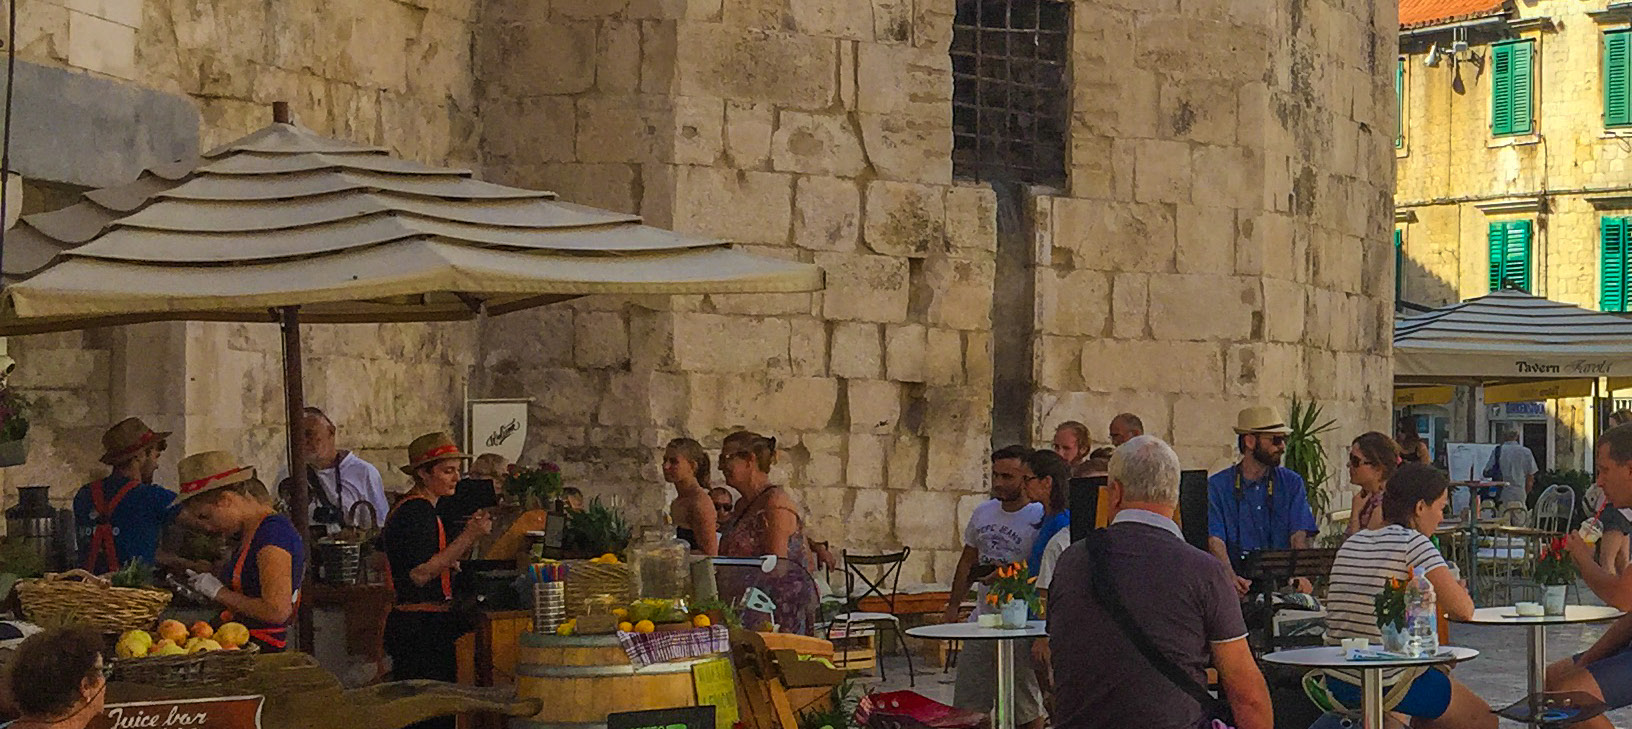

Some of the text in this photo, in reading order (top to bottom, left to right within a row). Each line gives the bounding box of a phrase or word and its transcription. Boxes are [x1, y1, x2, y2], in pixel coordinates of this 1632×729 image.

[1515, 361, 1560, 373] Tavern
[108, 705, 208, 729] Juice bar
